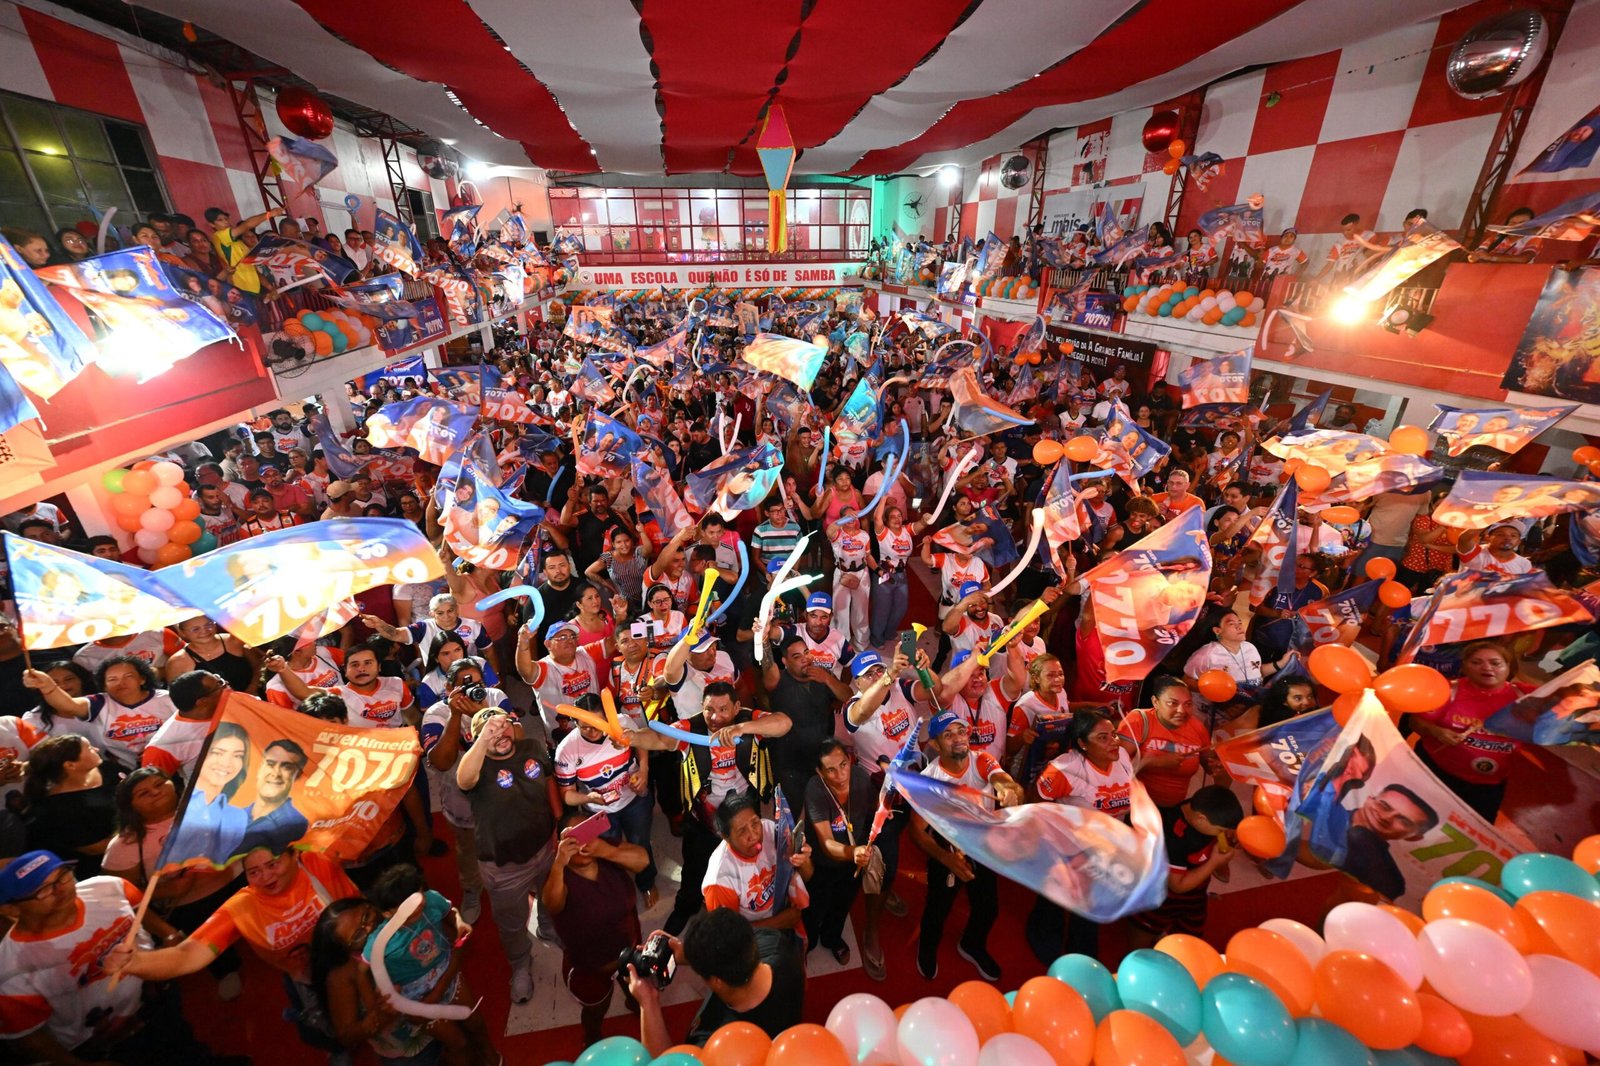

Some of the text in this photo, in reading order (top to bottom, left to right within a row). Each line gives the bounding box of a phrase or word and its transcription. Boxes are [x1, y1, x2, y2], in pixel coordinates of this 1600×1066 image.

[594, 268, 836, 285] UMA ESCOLA QUE NÃO É SÓ DE SAMBA
[304, 743, 418, 793] 7070
